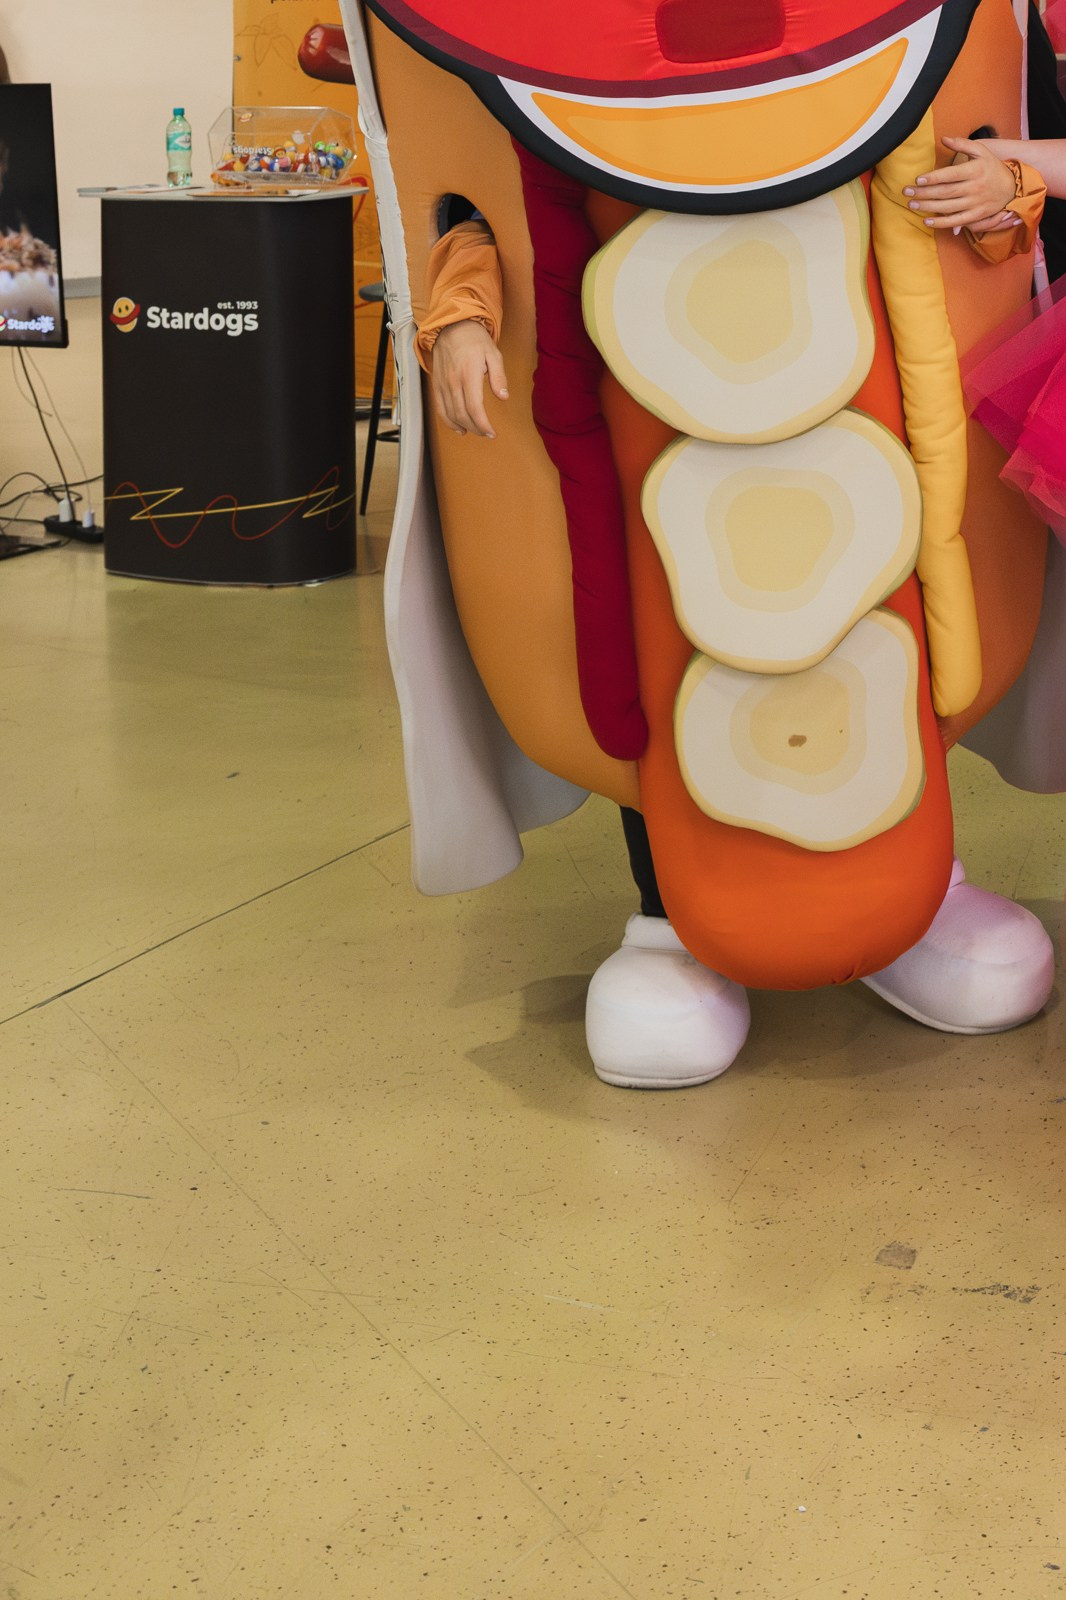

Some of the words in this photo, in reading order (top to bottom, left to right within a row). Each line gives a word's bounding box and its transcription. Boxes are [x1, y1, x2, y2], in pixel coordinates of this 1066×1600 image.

[217, 301, 235, 310] est.
[236, 300, 258, 310] 1993
[146, 305, 259, 337] Stardogs
